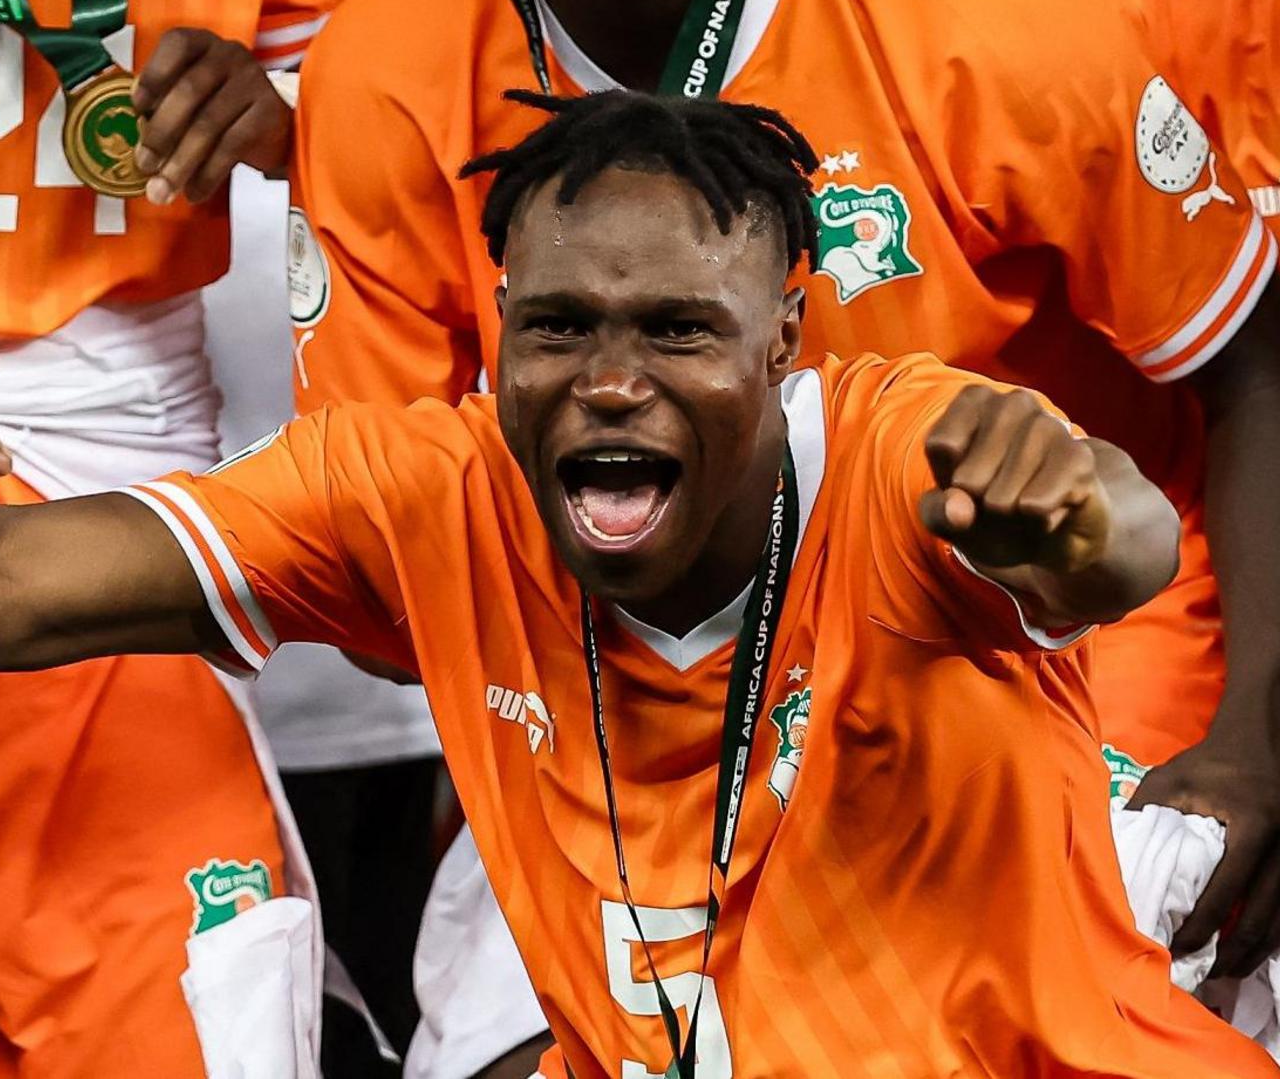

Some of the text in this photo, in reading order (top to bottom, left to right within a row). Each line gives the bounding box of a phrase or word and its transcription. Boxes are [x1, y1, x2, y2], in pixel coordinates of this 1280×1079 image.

[683, 57, 710, 100] CUP
[698, 28, 720, 59] OF
[766, 492, 785, 585] NATIONS
[761, 587, 774, 617] OF
[754, 619, 769, 663] CUP
[741, 663, 764, 740] AFRICA
[600, 898, 733, 1079] 5
